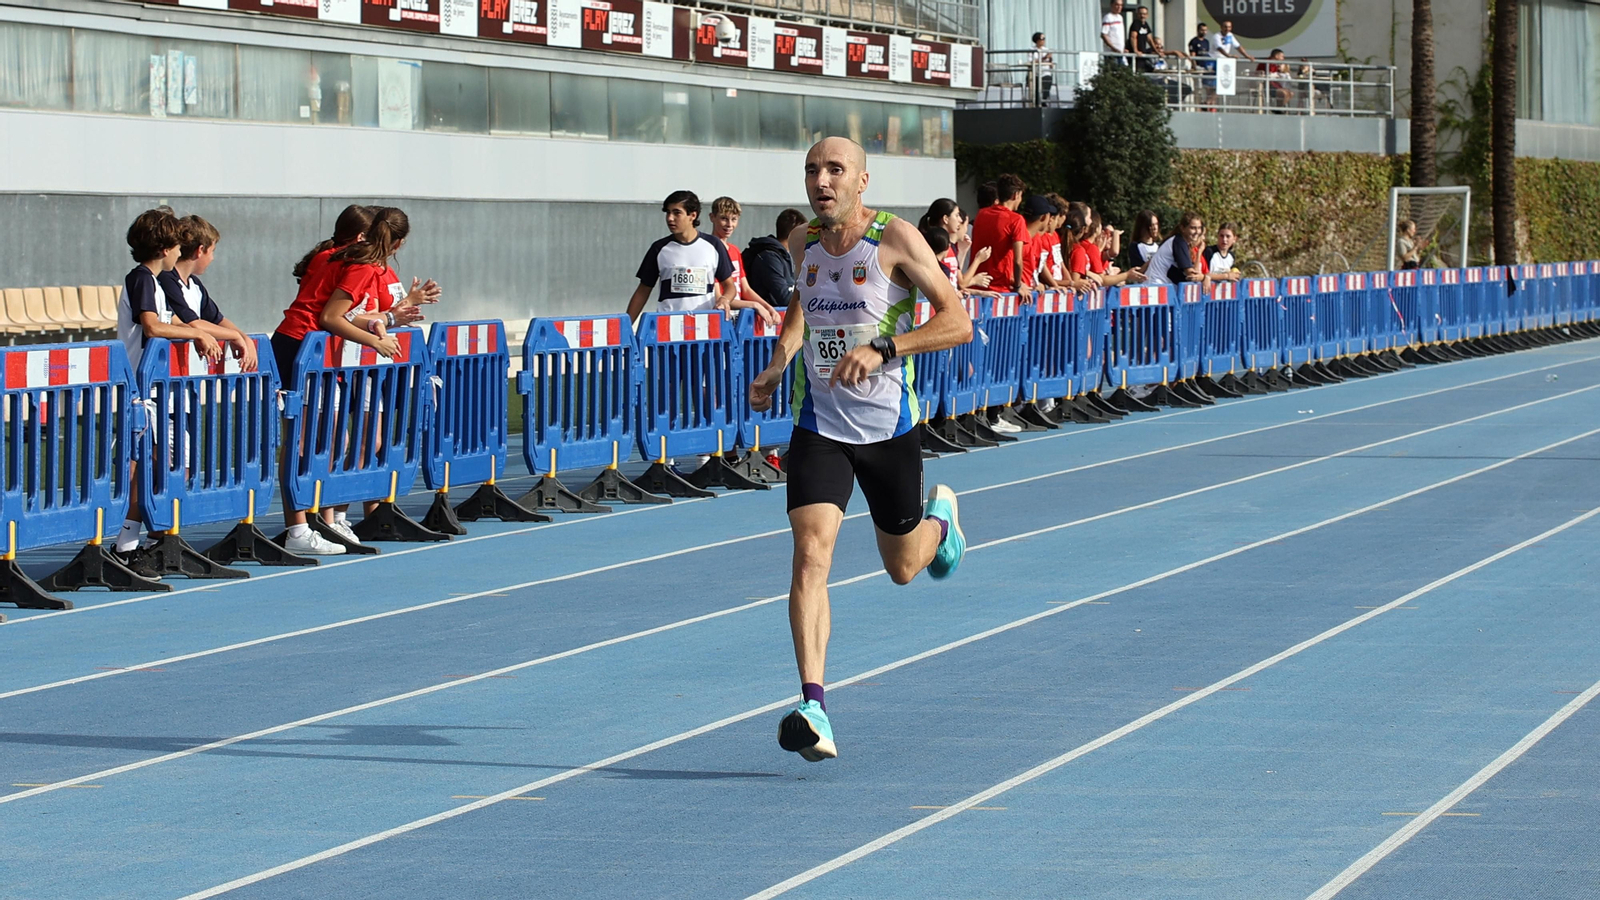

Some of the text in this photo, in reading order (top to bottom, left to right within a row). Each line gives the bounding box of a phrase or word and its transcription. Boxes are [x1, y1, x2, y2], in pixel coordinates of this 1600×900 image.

[481, 0, 508, 20] PLAY
[1222, 0, 1296, 14] HOTELS
[584, 8, 609, 31] PLAY
[776, 34, 796, 55] PLAY
[672, 273, 695, 284] 1680
[807, 297, 868, 314] Chipiona
[817, 340, 847, 360] 863
